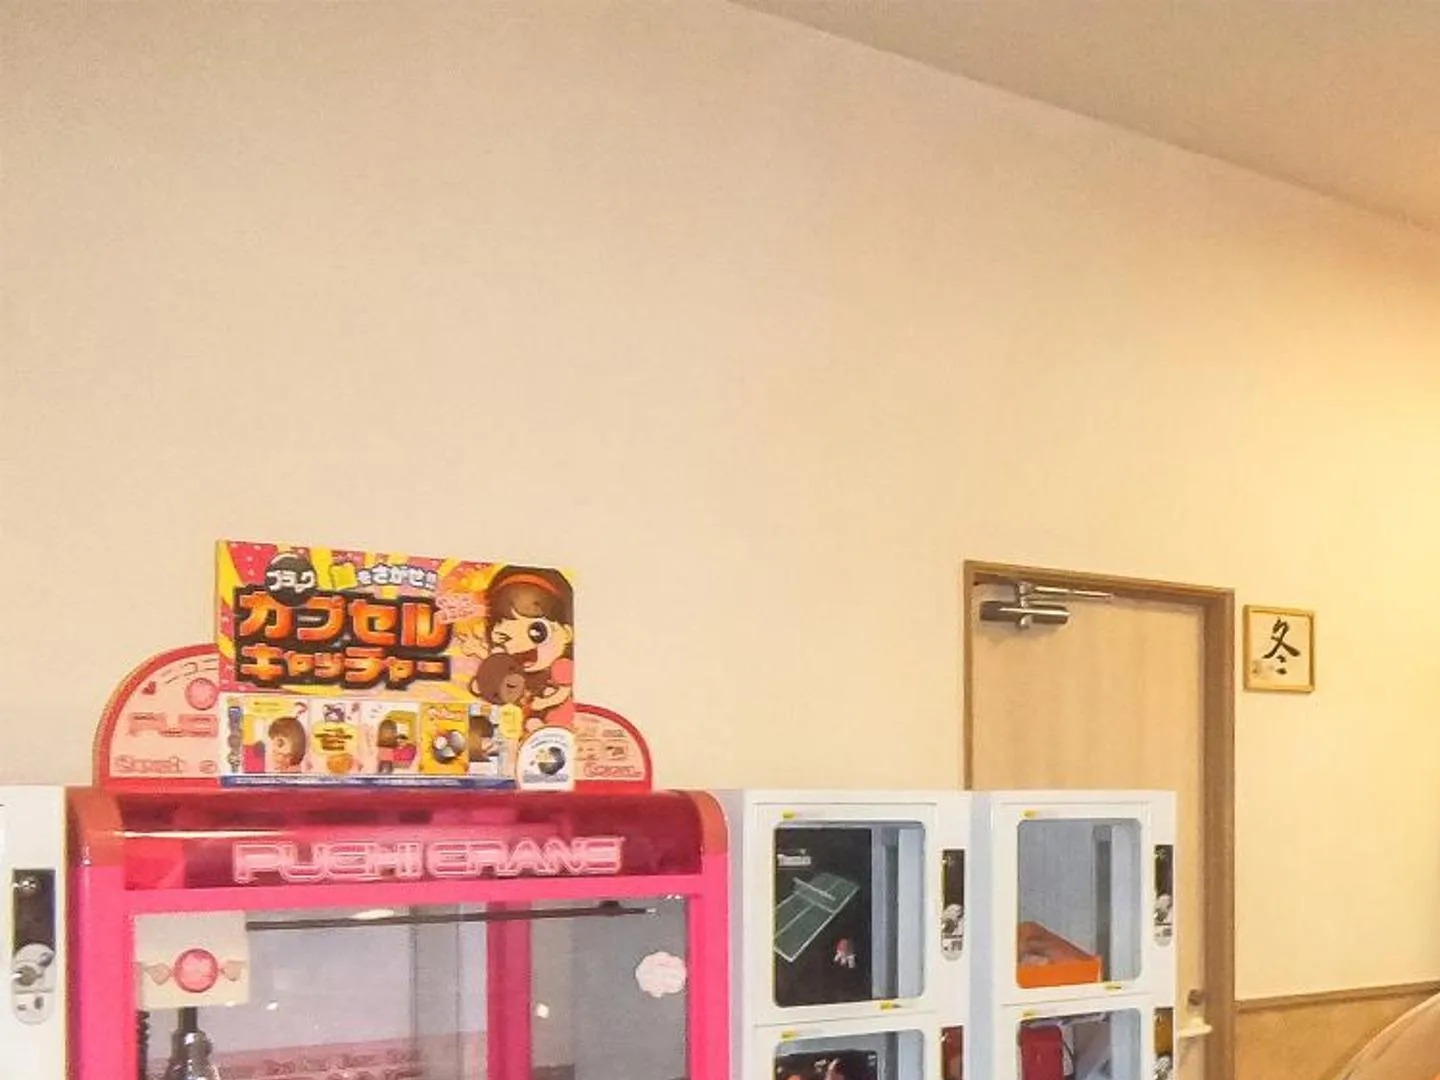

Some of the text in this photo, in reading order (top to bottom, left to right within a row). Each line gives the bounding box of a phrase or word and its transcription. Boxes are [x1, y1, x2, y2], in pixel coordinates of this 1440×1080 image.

[238, 591, 448, 648] カプセル
[1262, 616, 1301, 675] 冬
[240, 642, 444, 682] キャッチャー
